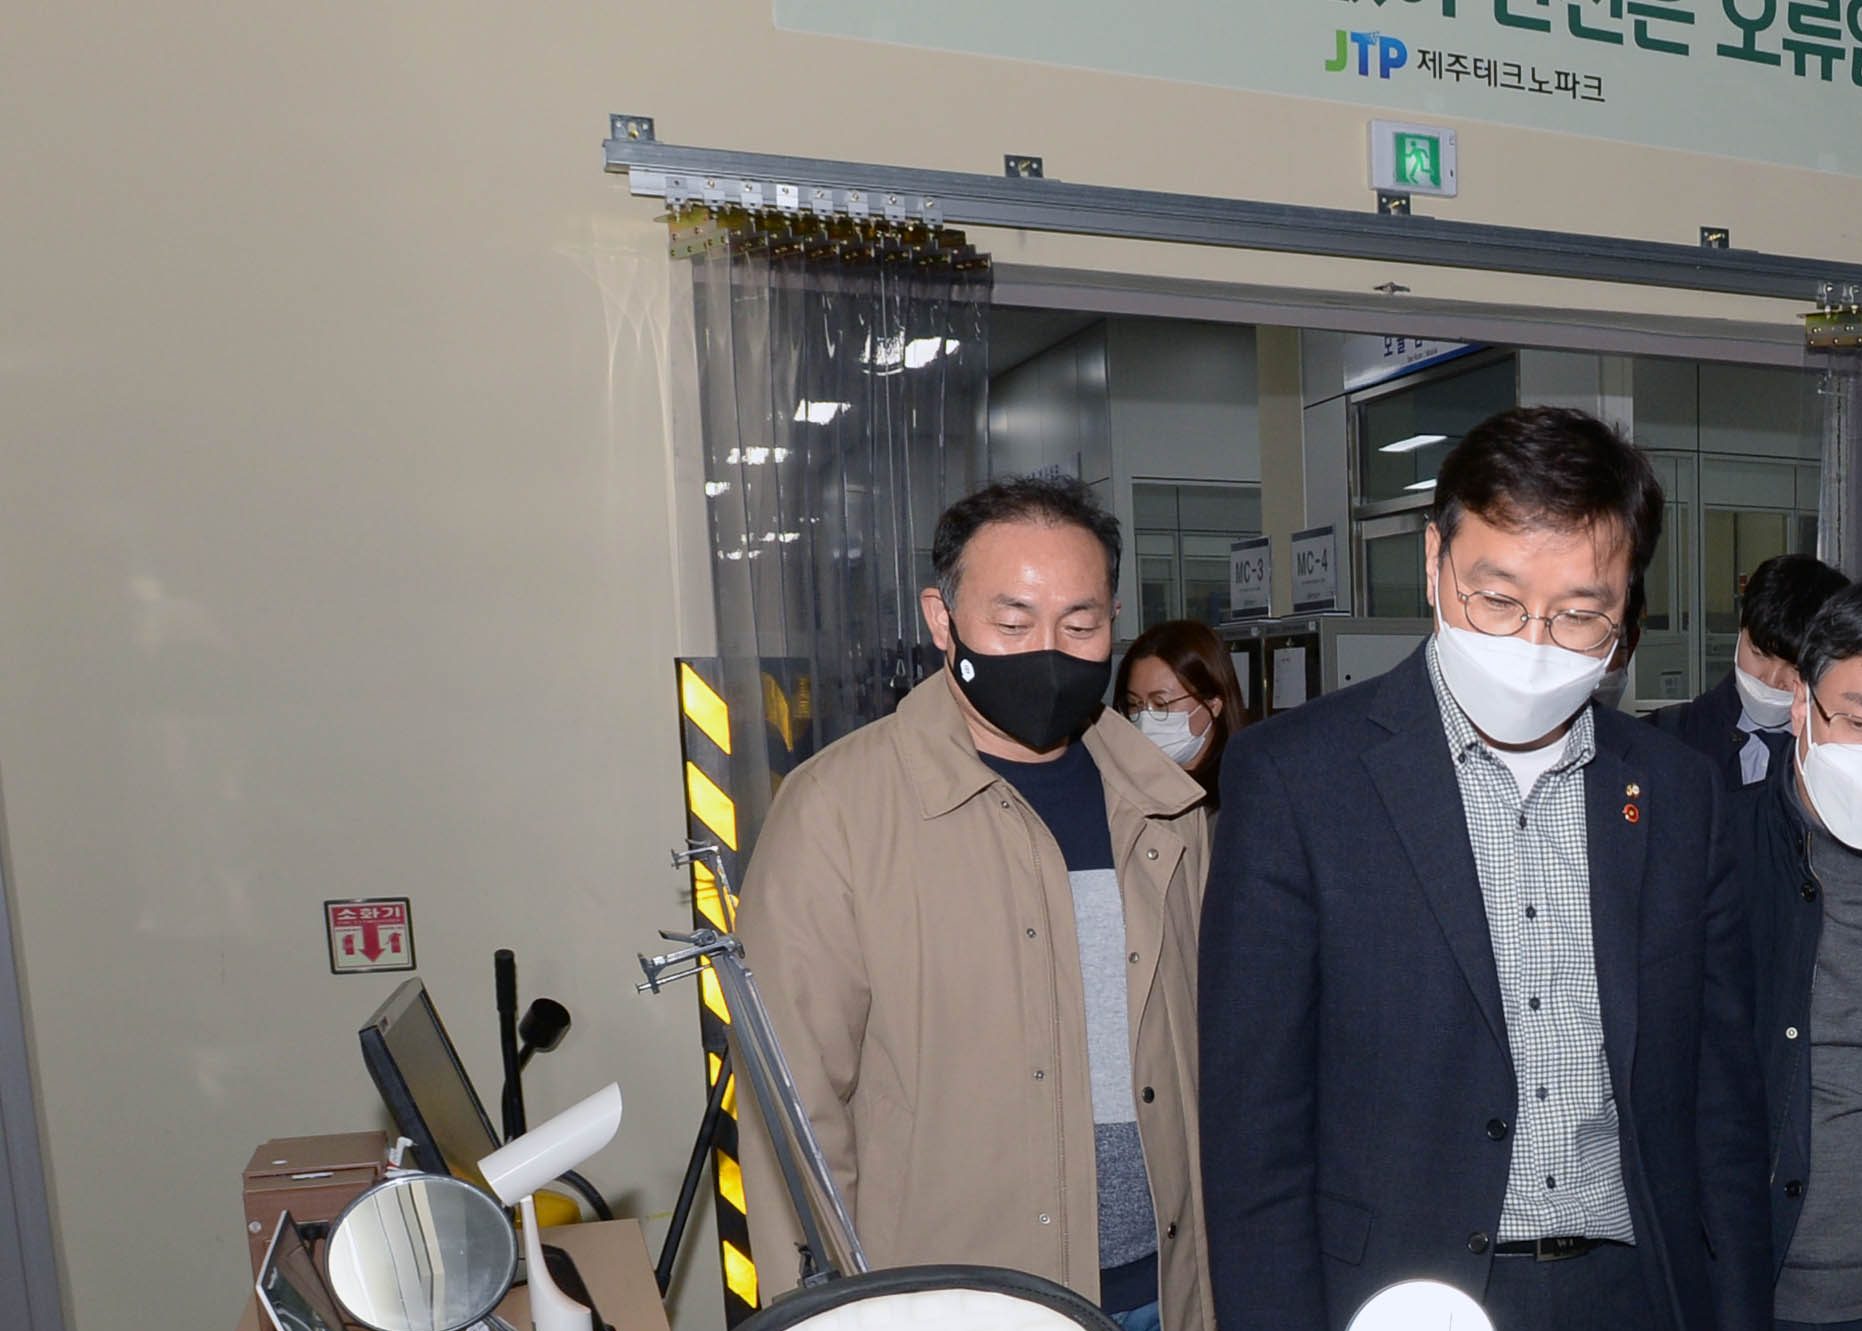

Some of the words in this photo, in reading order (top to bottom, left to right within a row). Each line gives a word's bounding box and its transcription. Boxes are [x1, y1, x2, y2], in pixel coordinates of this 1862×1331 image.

[1324, 29, 1408, 80] JTP
[1416, 48, 1606, 102] 제주테크노파크
[1235, 557, 1265, 585] MC-3
[1296, 548, 1328, 577] MC-4
[337, 906, 401, 920] 소화기
